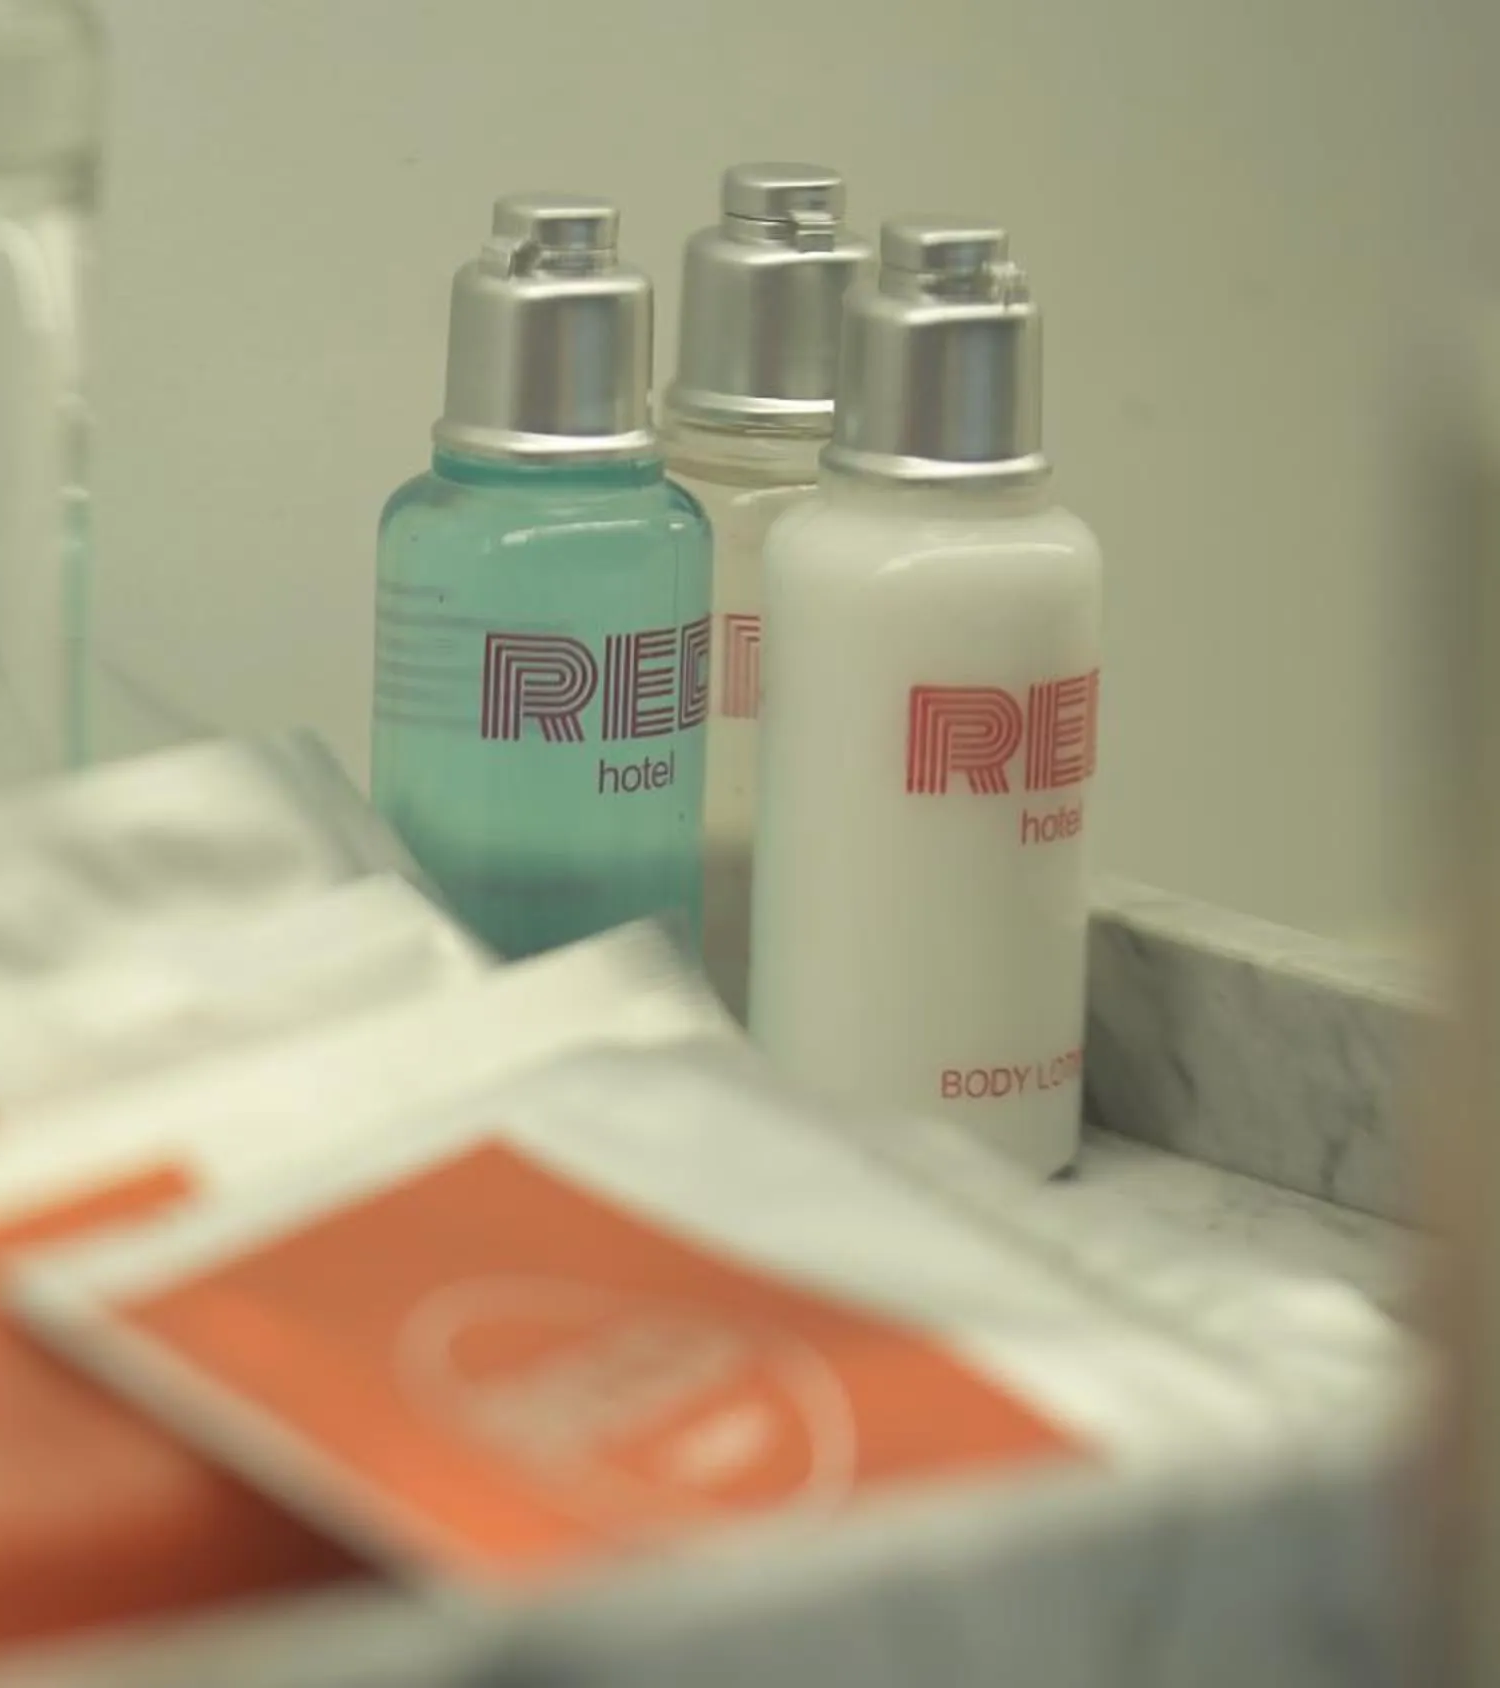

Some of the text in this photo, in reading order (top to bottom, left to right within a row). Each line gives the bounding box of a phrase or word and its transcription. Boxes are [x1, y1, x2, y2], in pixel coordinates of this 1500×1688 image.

[905, 667, 1100, 795] RE
[598, 752, 675, 794] hotel
[940, 1065, 1033, 1099] BODY
